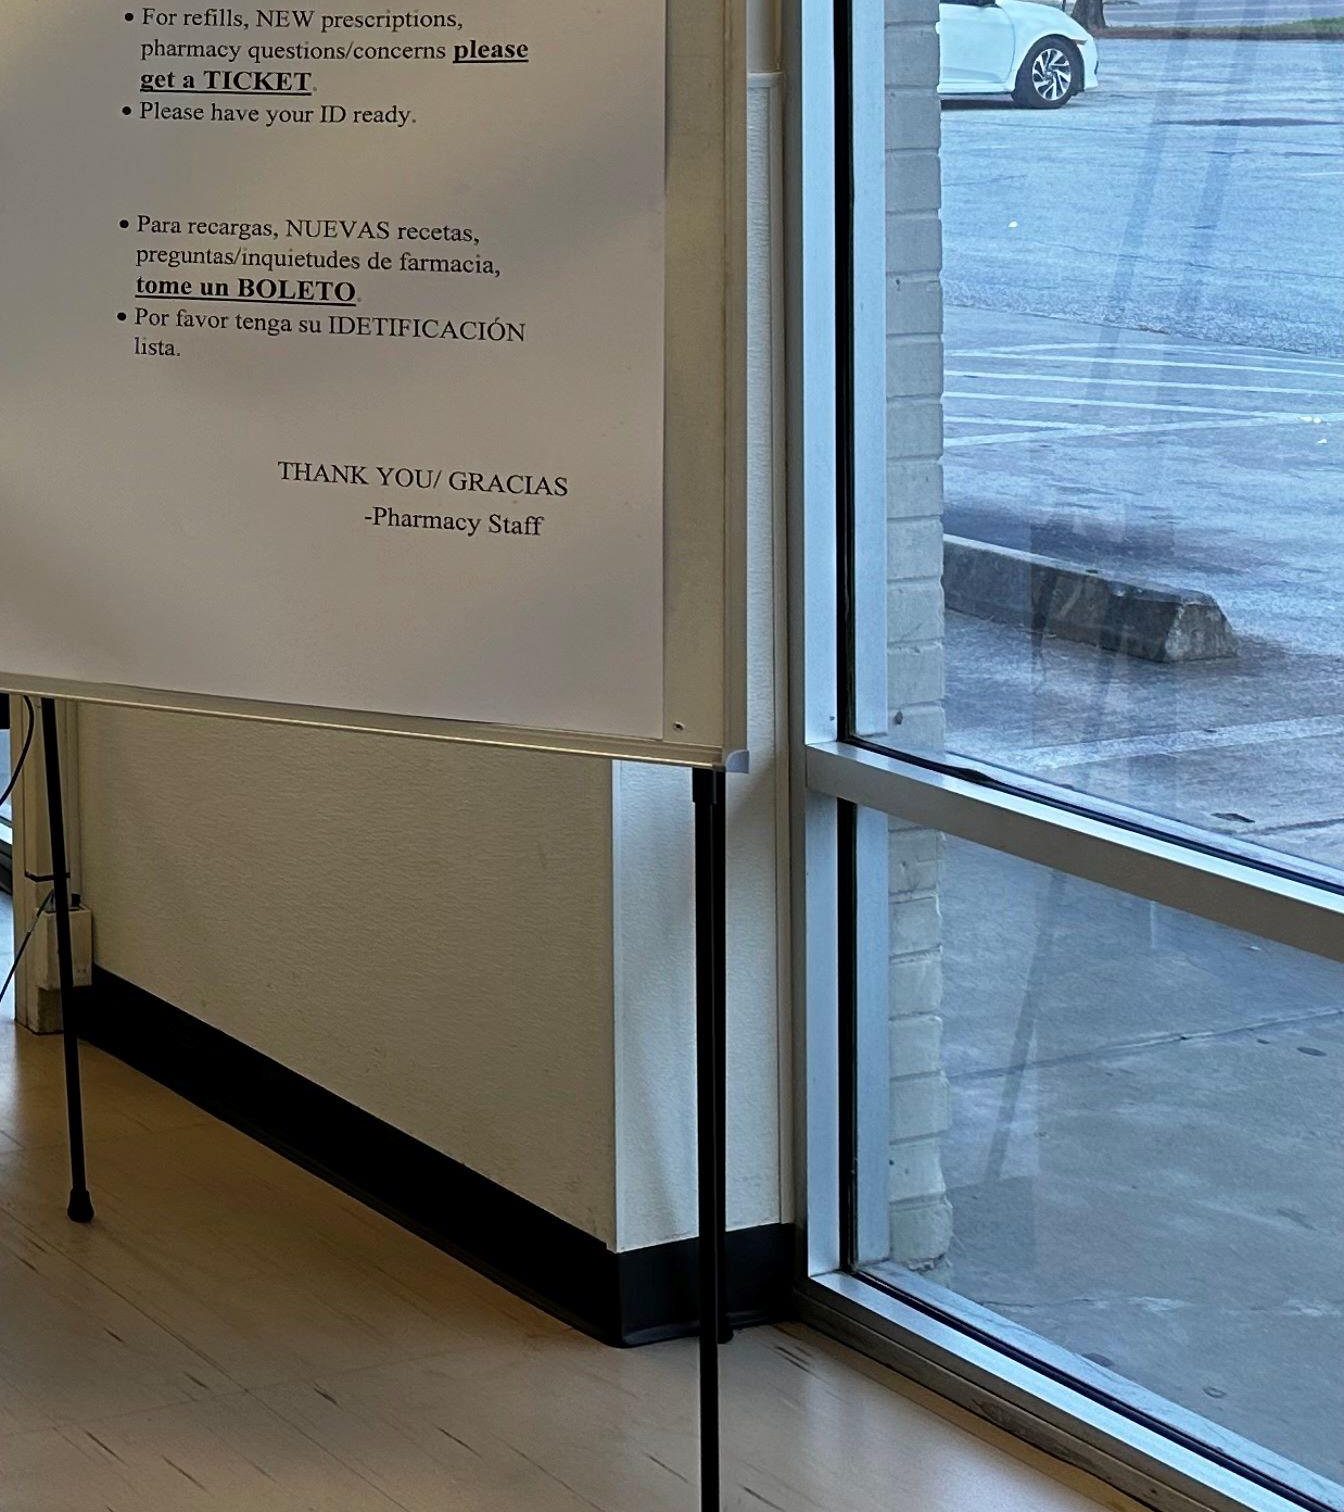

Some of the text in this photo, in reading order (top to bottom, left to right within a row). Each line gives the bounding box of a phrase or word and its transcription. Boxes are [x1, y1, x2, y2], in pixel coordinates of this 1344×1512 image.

[142, 7, 463, 33] For refills, NEW prescriptions,
[141, 38, 529, 64] pharmacy questions/concerns please
[139, 72, 177, 93] get
[178, 75, 197, 94] a
[140, 101, 416, 128] Please have your ID ready.
[137, 214, 479, 245] Para recargas, NUEVAS recetas,
[137, 249, 500, 278] preguntas/inquietudes de farmacia,
[135, 276, 193, 301] tome
[197, 282, 230, 302] un
[135, 307, 524, 342] Por favor tenga su IDETIFICACIÓN
[134, 336, 181, 357] lista.
[277, 461, 568, 497] THANK YOU/ GRACIAS
[365, 506, 544, 537] -Pharmacy Staff
